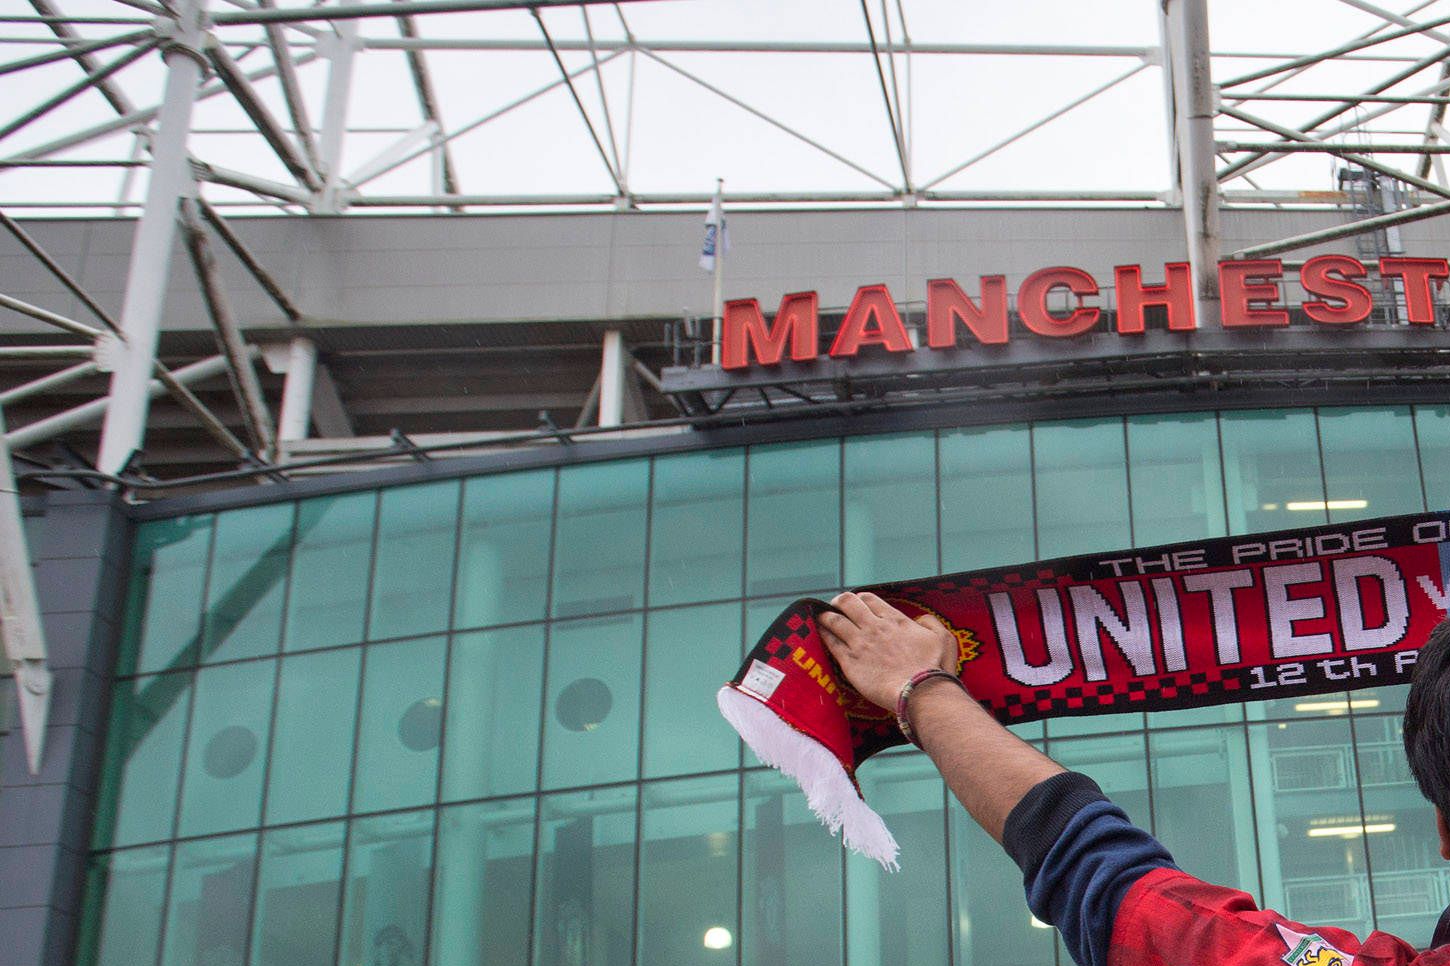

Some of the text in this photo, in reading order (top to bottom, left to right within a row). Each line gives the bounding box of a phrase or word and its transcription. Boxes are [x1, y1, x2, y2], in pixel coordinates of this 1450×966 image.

[1105, 547, 1206, 577] THE
[1233, 527, 1388, 563] PRIDE
[989, 554, 1410, 687] UNITED
